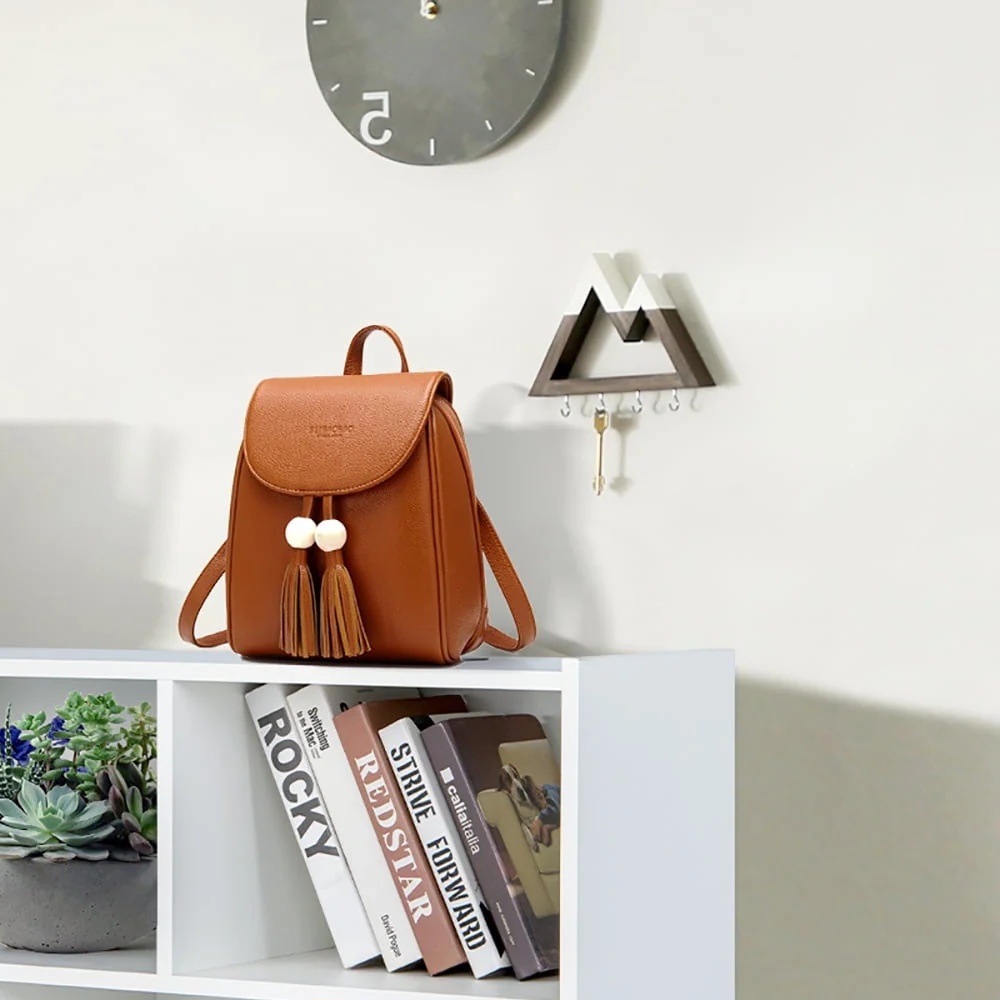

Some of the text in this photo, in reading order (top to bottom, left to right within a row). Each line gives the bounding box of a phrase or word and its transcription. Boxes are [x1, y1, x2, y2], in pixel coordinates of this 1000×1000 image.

[303, 727, 317, 748] Mac
[307, 706, 330, 751] Switching
[257, 706, 340, 859] ROCKY
[353, 749, 433, 924] REDSTAR
[390, 742, 486, 951] STRIVE FORWARD
[447, 784, 481, 856] caliaitalia
[380, 914, 402, 958] David Pogue
